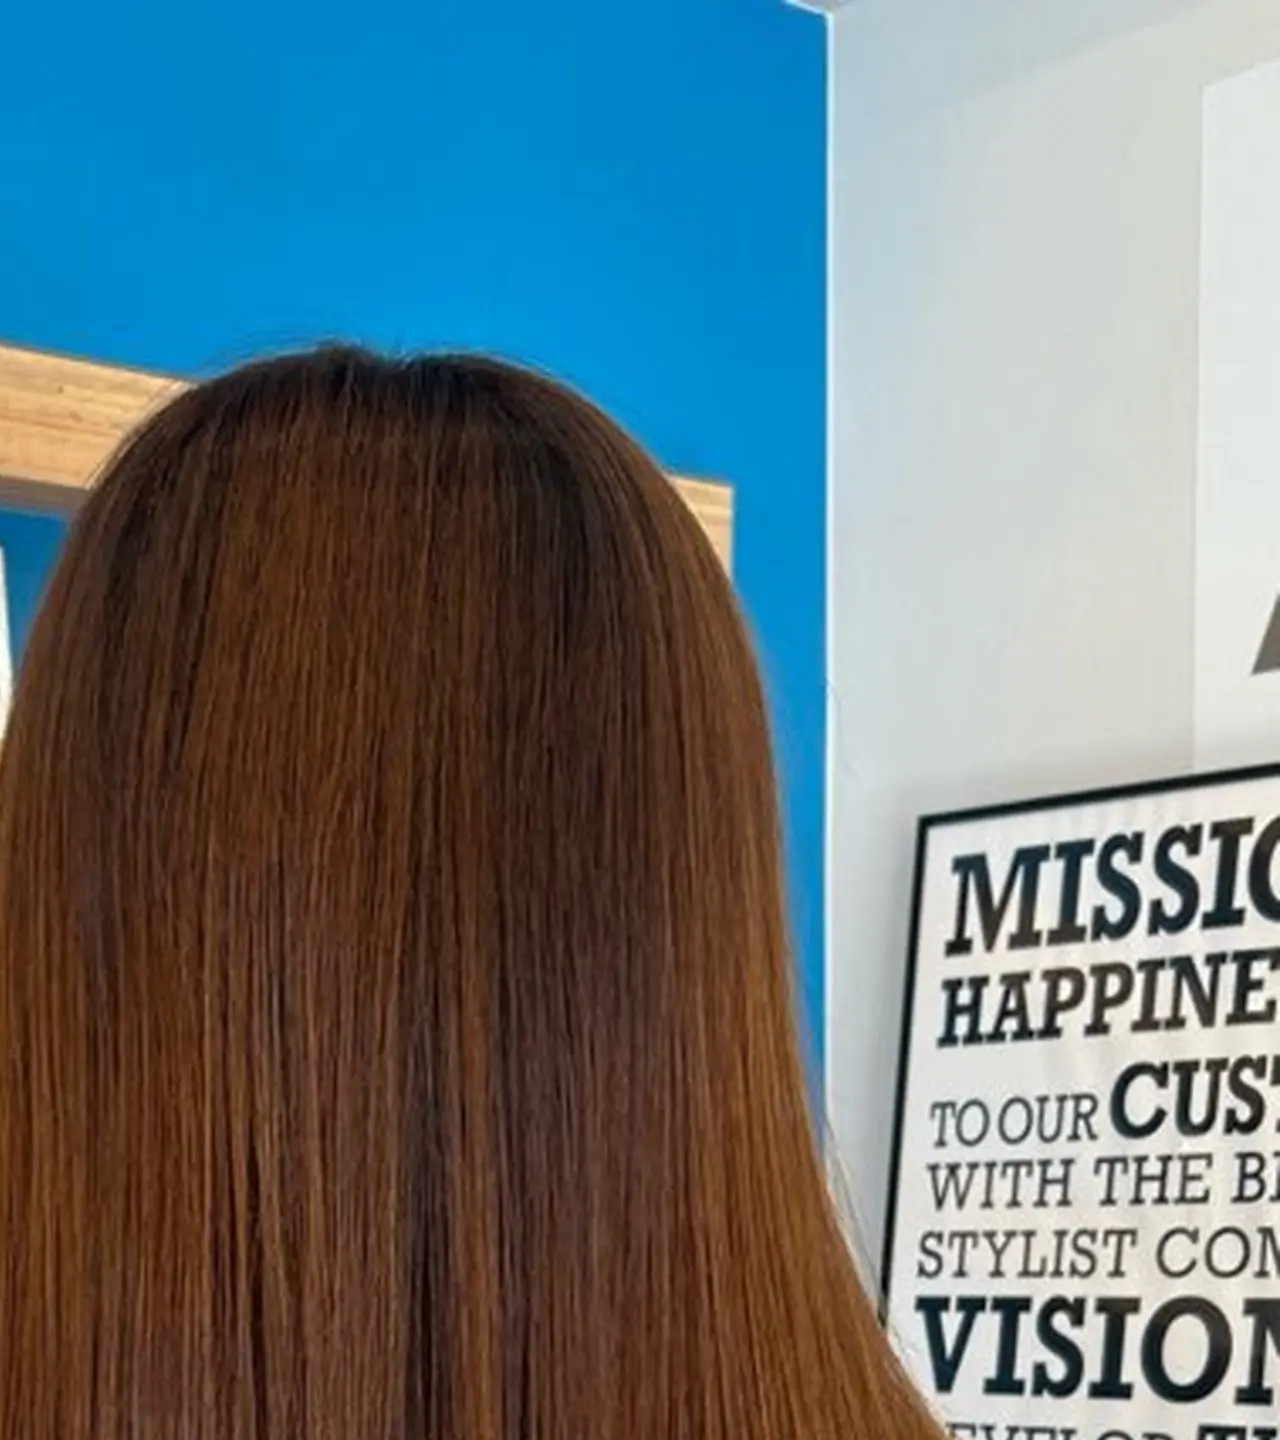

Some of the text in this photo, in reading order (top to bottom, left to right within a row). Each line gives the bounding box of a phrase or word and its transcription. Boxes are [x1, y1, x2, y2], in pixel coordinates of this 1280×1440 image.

[936, 947, 1280, 1049] HAPPINE
[929, 1054, 1280, 1149] TO OUR CUS
[925, 1149, 1280, 1212] WITH THE B
[916, 1227, 1138, 1279] STYLIST
